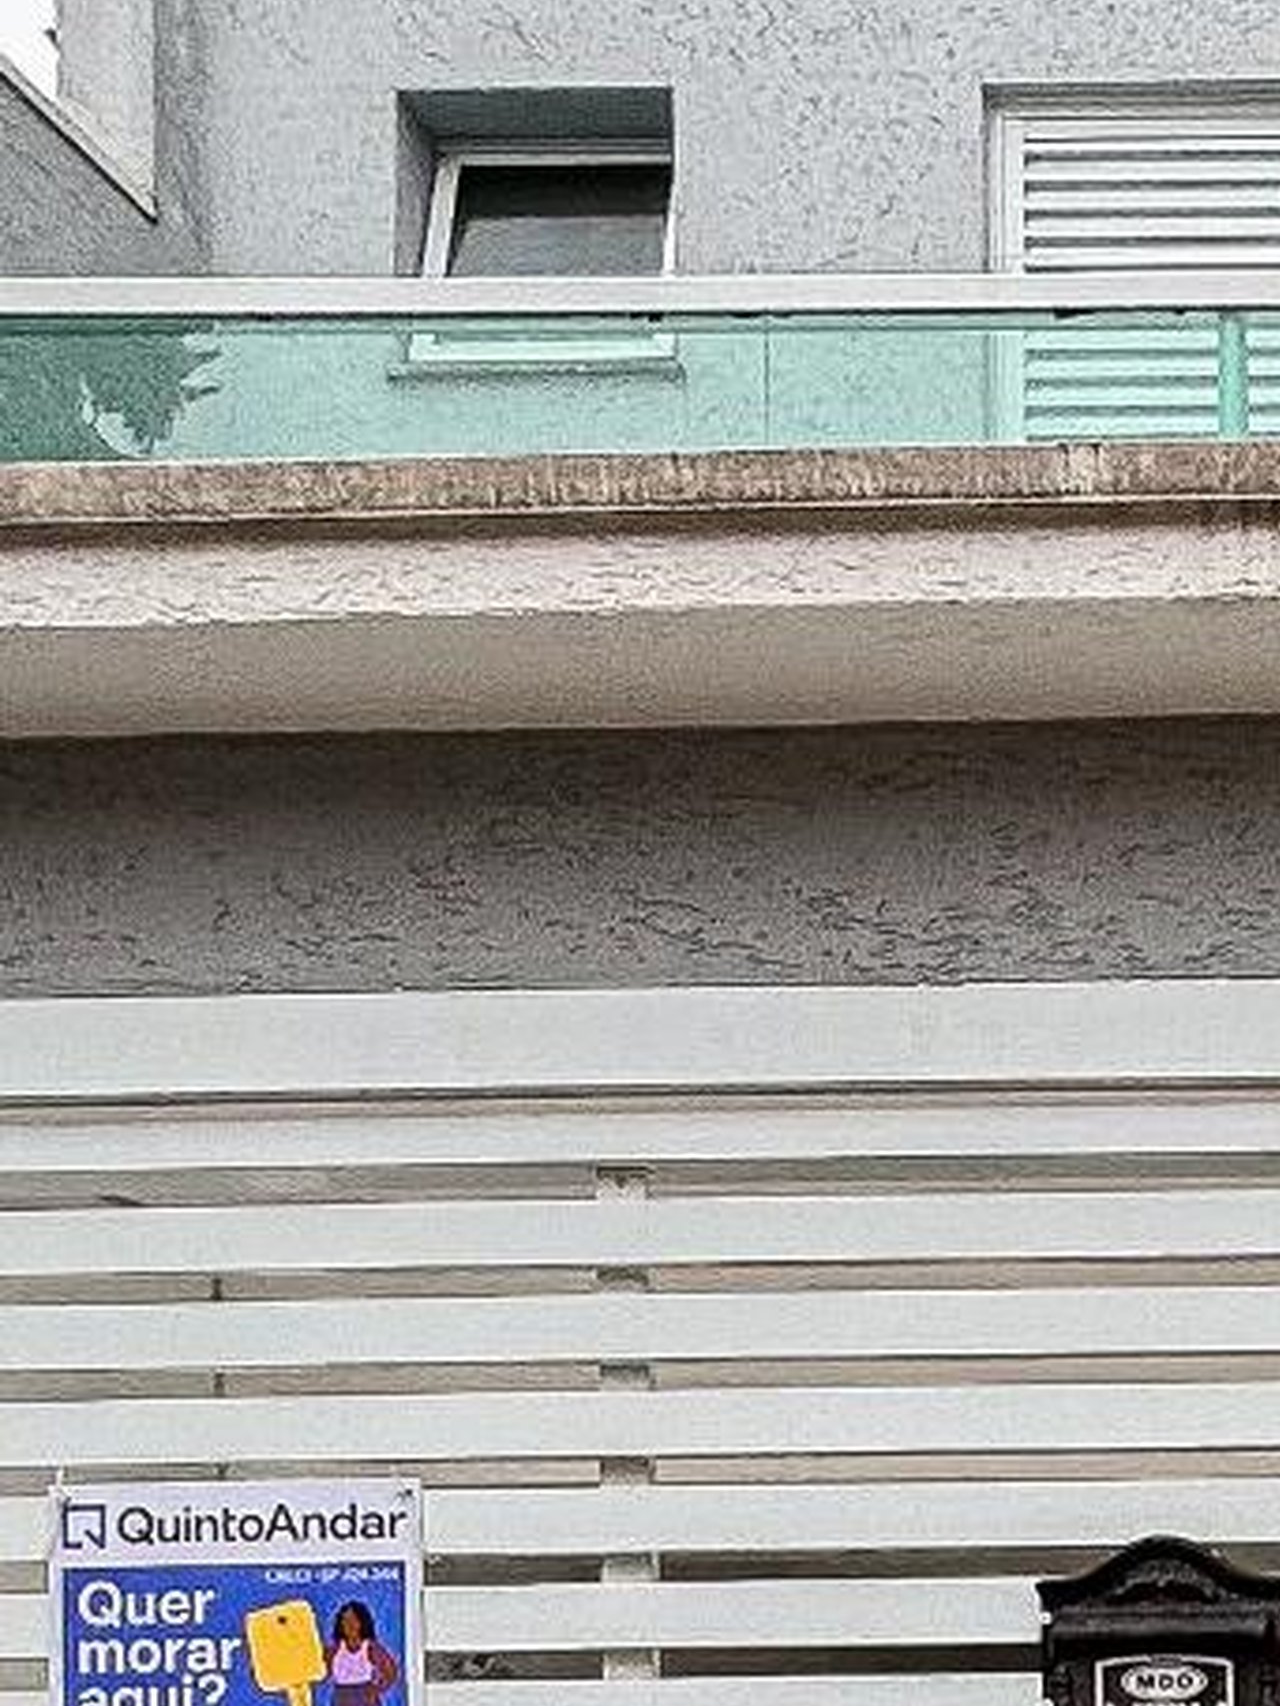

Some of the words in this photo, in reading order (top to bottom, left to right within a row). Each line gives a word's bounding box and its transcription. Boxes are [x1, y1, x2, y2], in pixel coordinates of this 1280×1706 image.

[117, 1503, 407, 1545] QuintoAndar
[78, 1580, 216, 1627] Quer
[78, 1637, 242, 1674] morar
